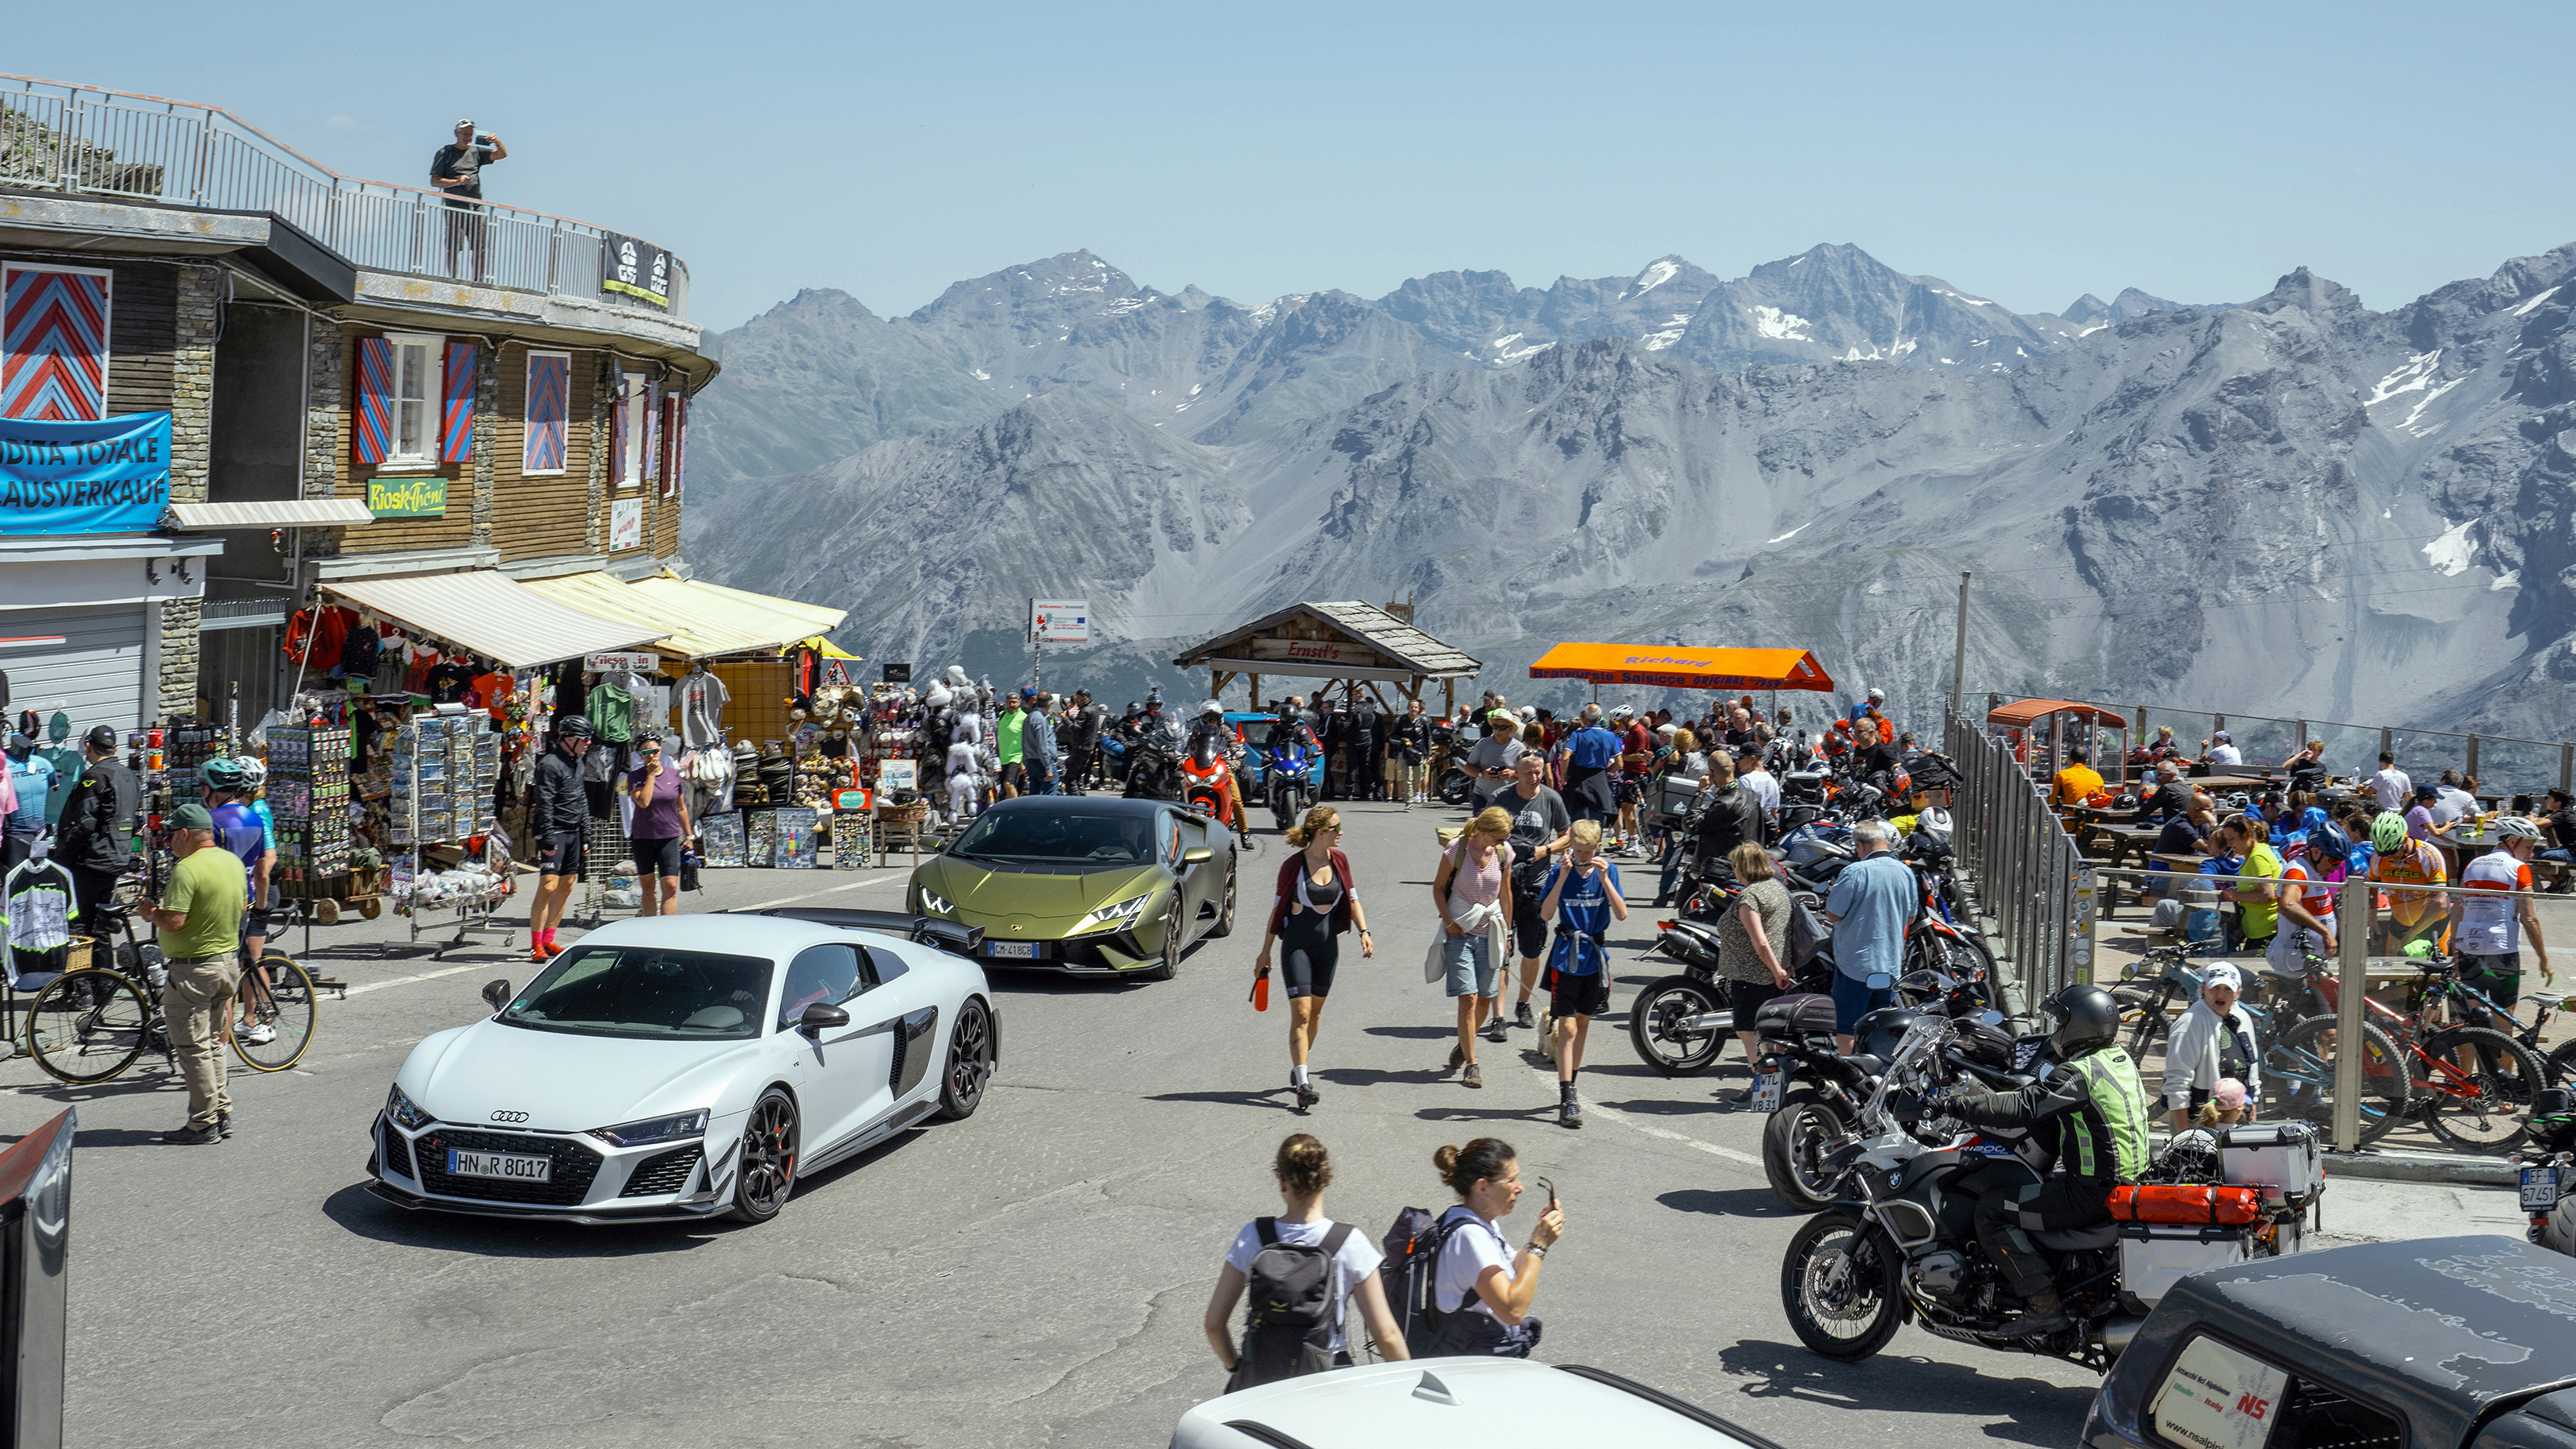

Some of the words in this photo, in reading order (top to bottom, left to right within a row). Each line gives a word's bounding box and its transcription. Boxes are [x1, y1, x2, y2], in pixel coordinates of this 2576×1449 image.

[71, 437, 158, 465] TOTALE
[0, 477, 165, 508] AUSVERKAUF
[369, 484, 409, 510] Kiosk
[1288, 642, 1339, 659] Ernstl's
[1624, 656, 1713, 667] Richard
[1534, 668, 1614, 681] Bratwürste
[1622, 671, 1686, 684] Salsicce
[1693, 676, 1744, 685] ORIGINAL
[1761, 1075, 1778, 1085] WTL
[1752, 1100, 1764, 1111] YB
[1765, 1100, 1776, 1109] 31
[457, 1154, 479, 1172] HN
[489, 1157, 500, 1174] R
[505, 1158, 547, 1178] 8017
[2530, 1170, 2543, 1183] EF
[2523, 1187, 2553, 1201] 67451
[2175, 1366, 2198, 1381] Attacchi
[2196, 1376, 2207, 1385] Sci
[2206, 1380, 2231, 1397] Alpinismo
[2174, 1382, 2194, 1397] Made
[2204, 1398, 2223, 1413] Italy
[2235, 1392, 2269, 1420] NS
